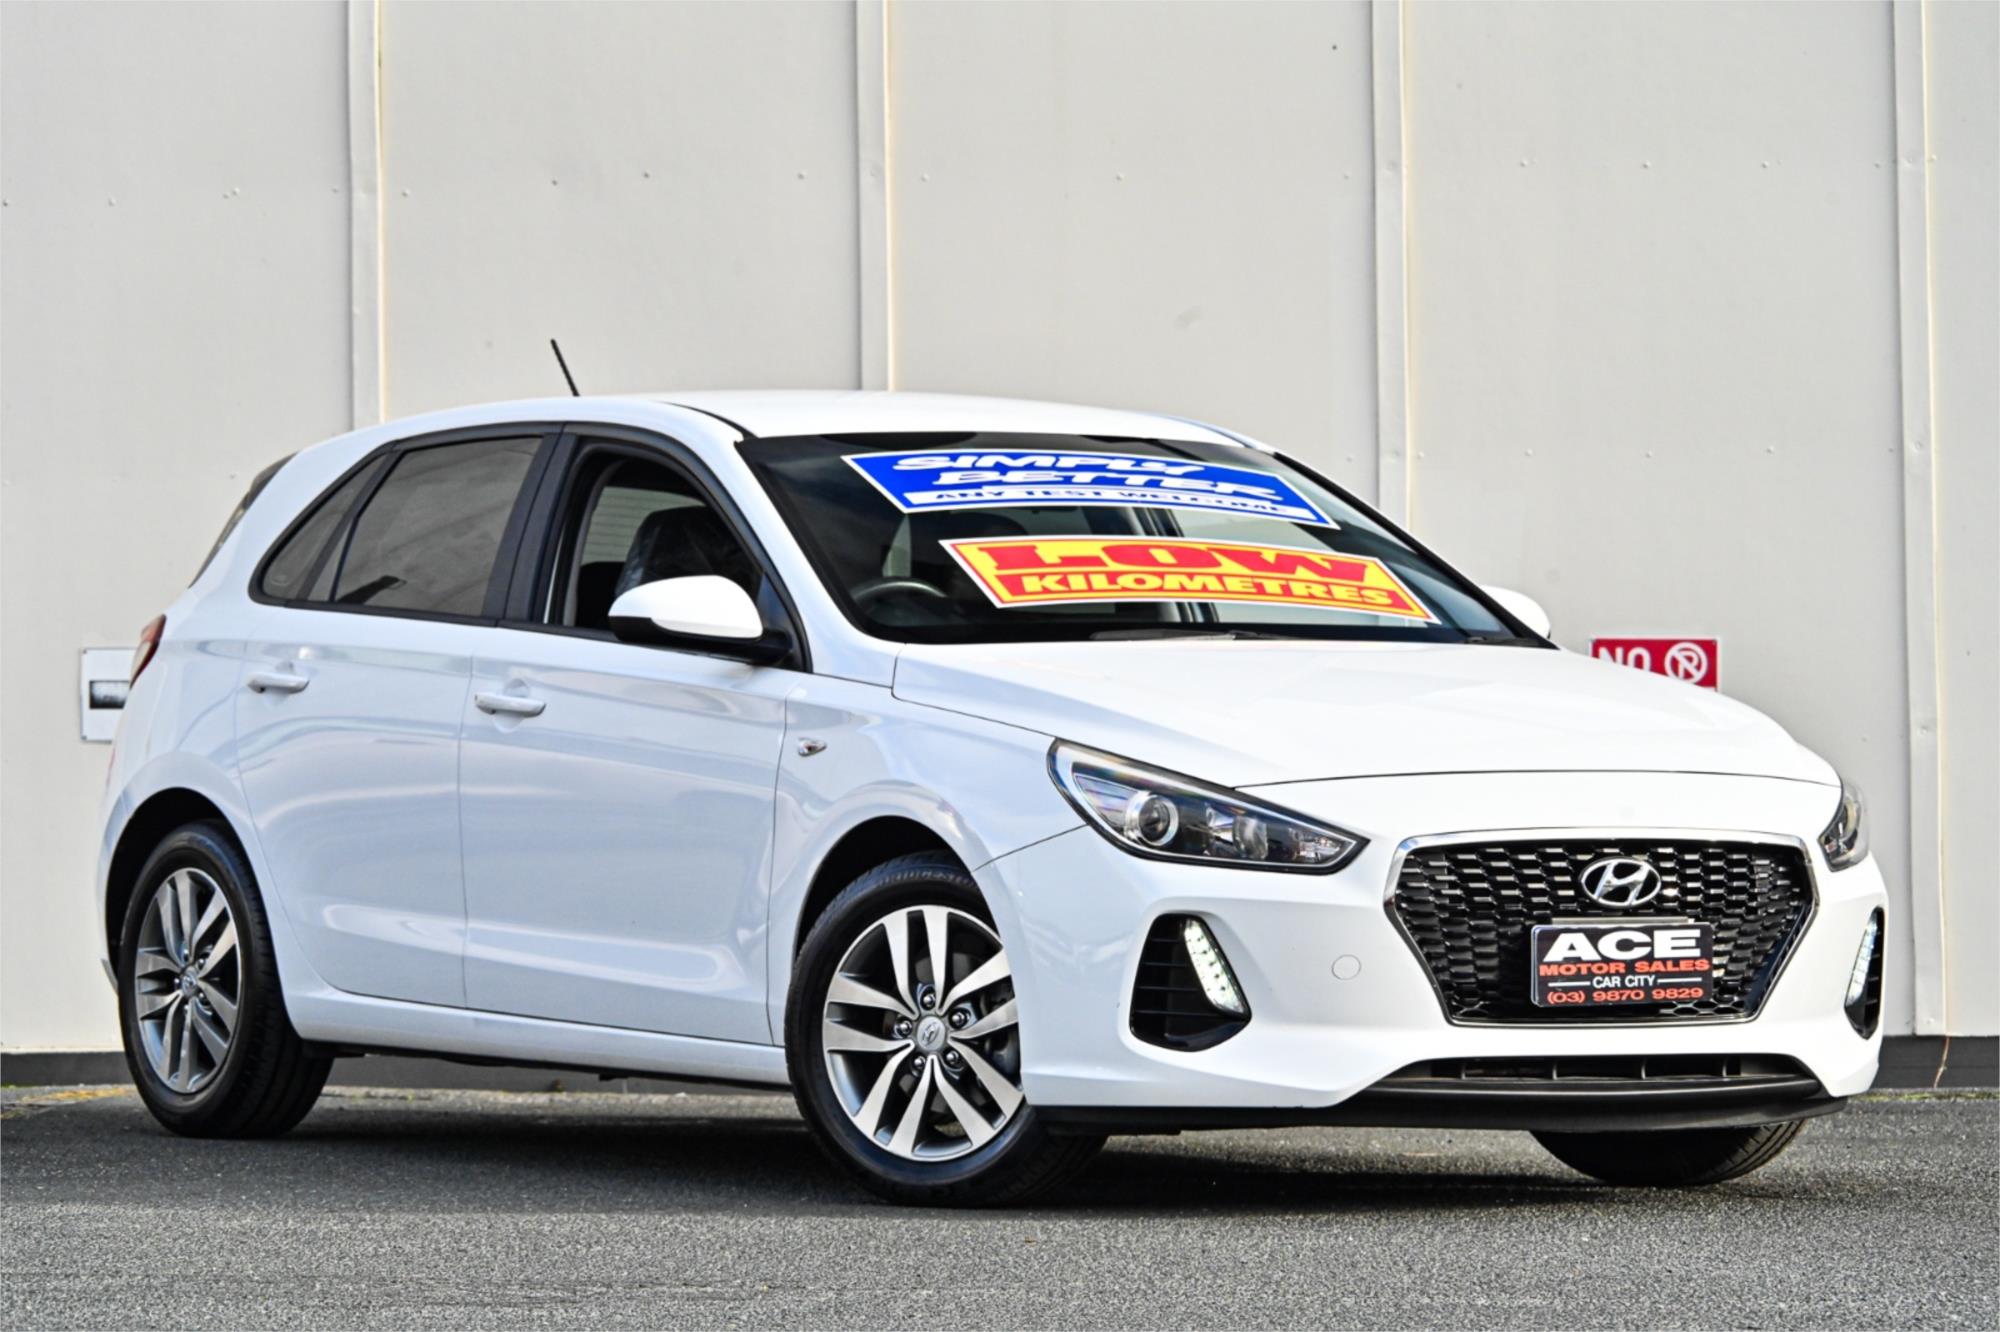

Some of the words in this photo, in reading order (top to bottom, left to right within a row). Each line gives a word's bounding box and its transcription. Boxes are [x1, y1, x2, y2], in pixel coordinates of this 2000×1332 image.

[893, 455, 1205, 475] SIMPLY
[932, 470, 1284, 501] BETTER
[935, 490, 1005, 499] ANY
[1018, 489, 1102, 497] TEST
[1117, 490, 1288, 512] WELCOME
[977, 544, 1368, 582] LOW
[1021, 573, 1393, 605] KILOMETRES
[1542, 929, 1701, 962] ACE
[1539, 962, 1625, 976] MOTOR
[1634, 958, 1710, 973] SALES
[1592, 976, 1620, 988] CAR
[1624, 974, 1656, 987] CITY
[1547, 990, 1586, 1004] (03)
[1592, 989, 1645, 1002] 9870
[1652, 987, 1704, 1000] 9829
